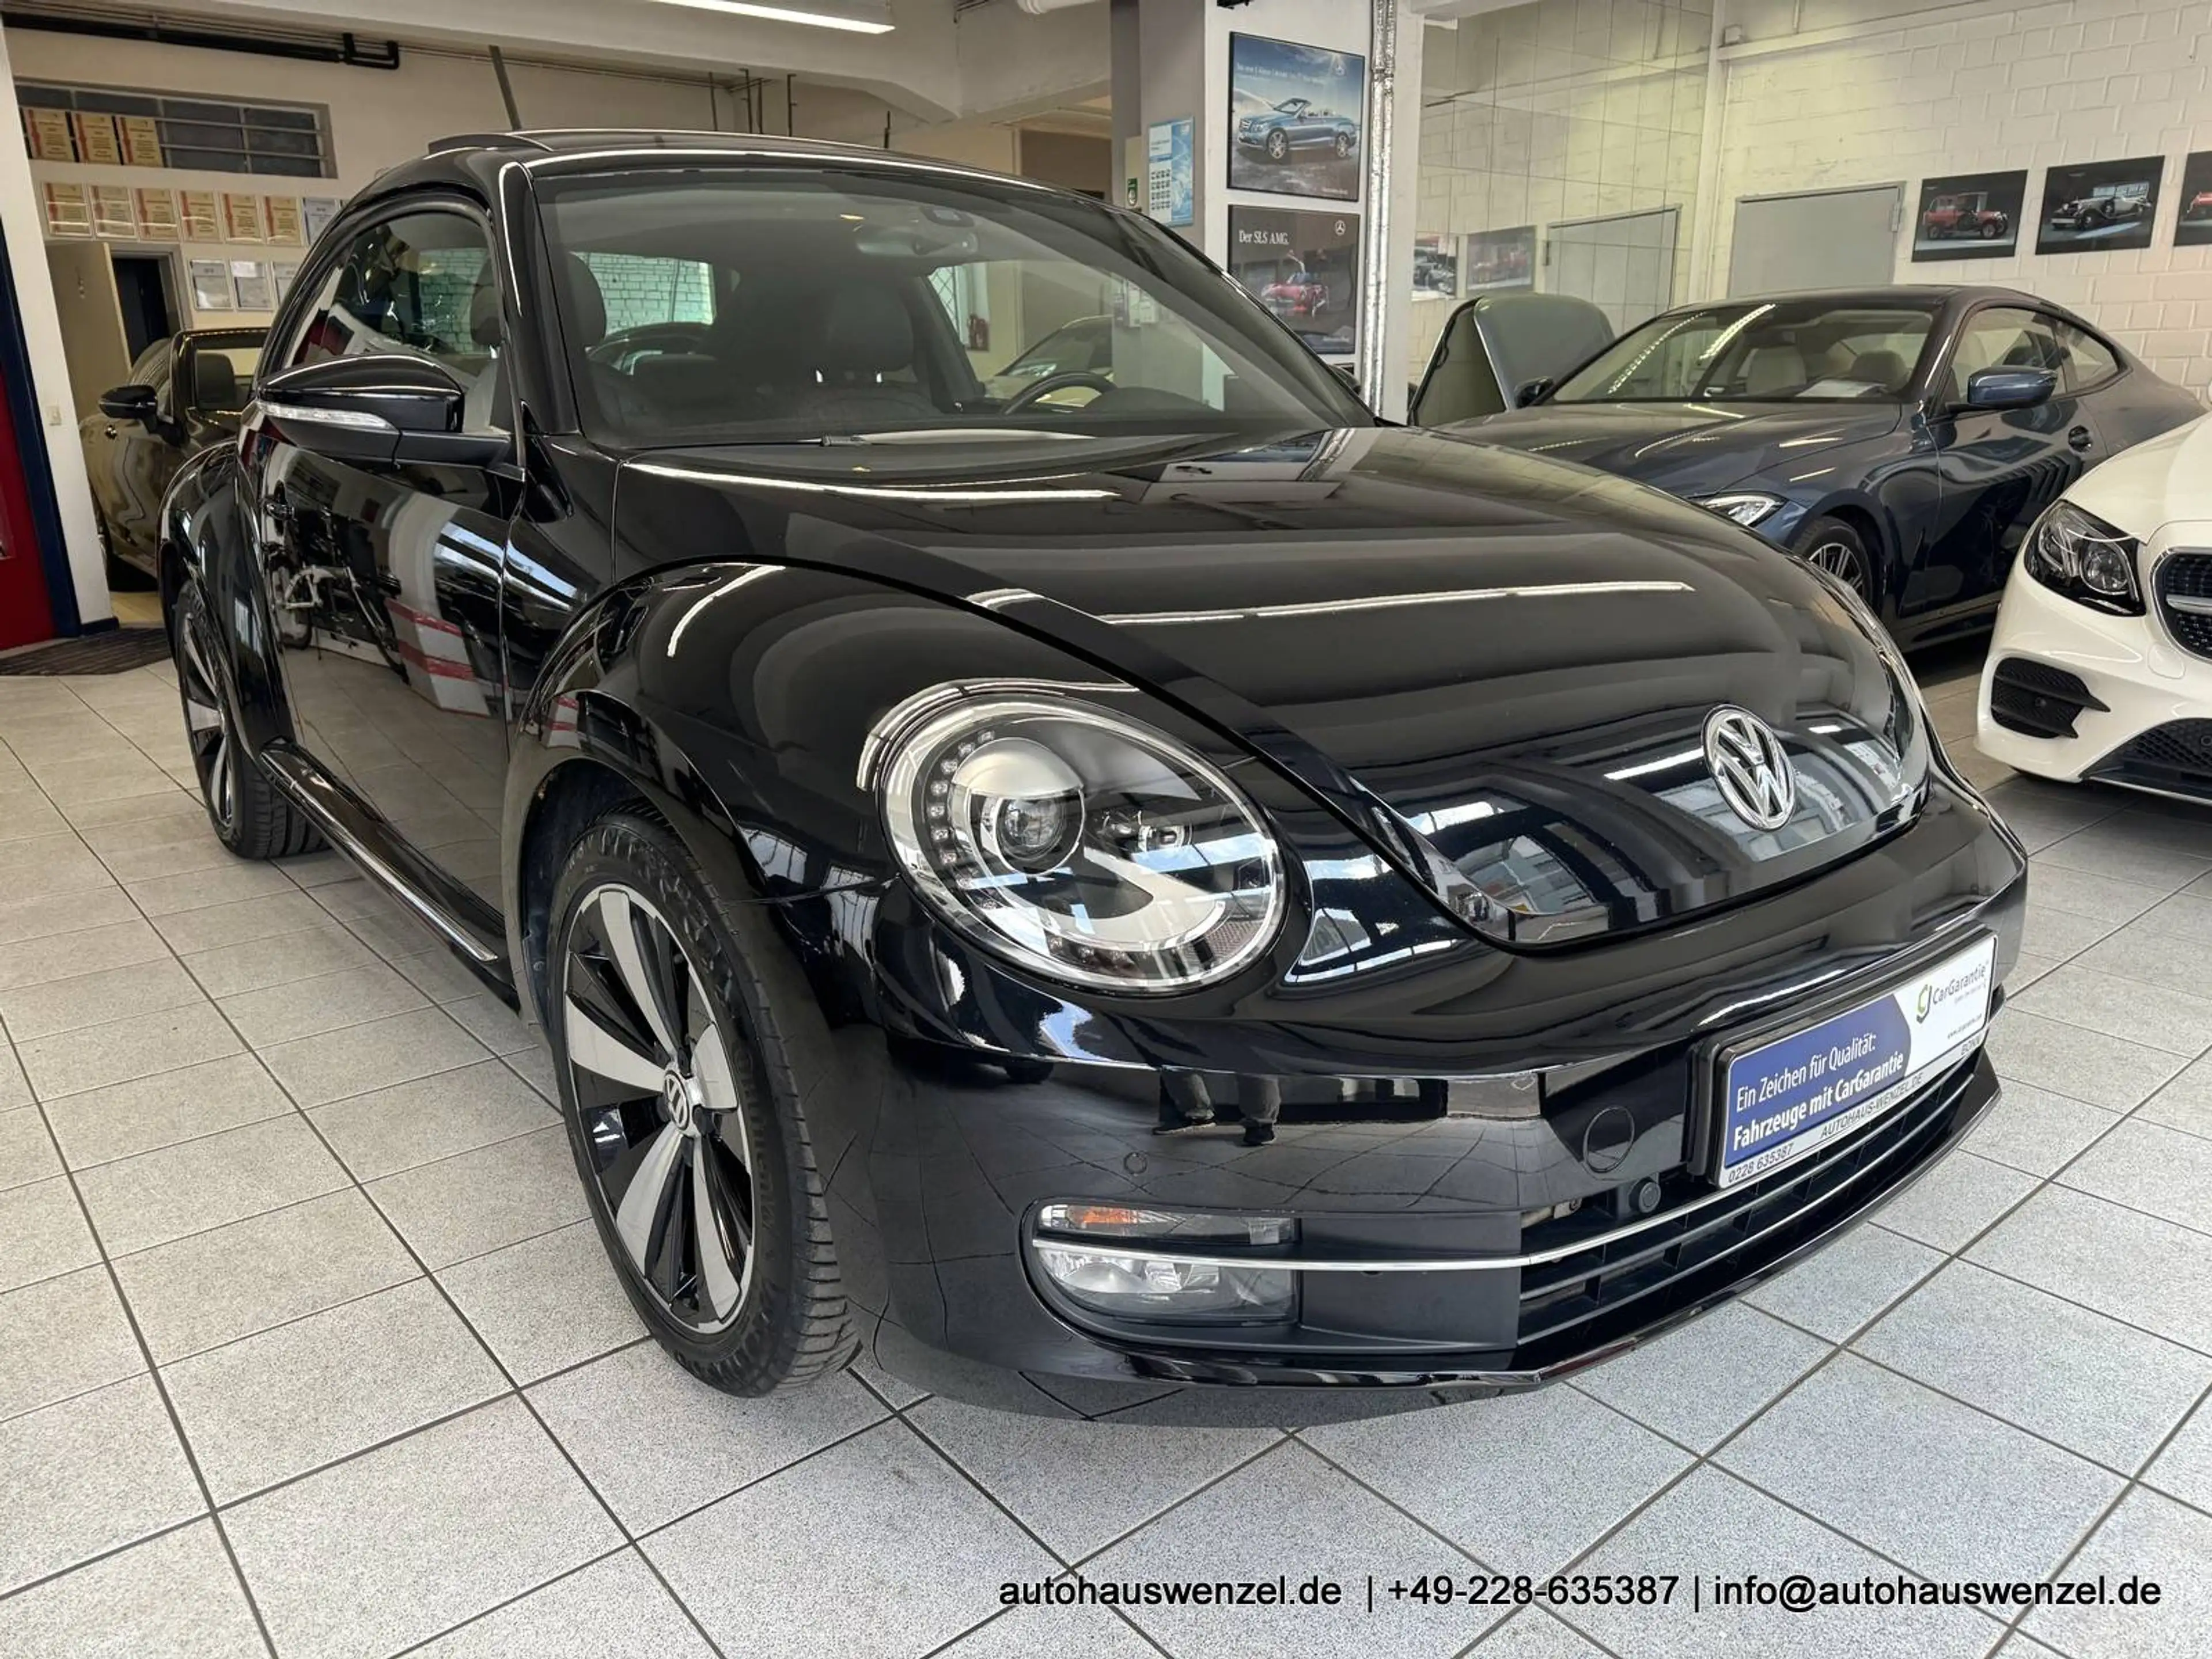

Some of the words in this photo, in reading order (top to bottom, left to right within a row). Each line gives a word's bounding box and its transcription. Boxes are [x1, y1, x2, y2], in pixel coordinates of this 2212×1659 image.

[1238, 230, 1252, 243] Der
[1253, 230, 1268, 244] SLS
[1933, 963, 1986, 1005] CarGarantie
[1736, 1085, 1757, 1112] Ein
[1759, 1064, 1806, 1103] Zeichen
[1809, 1054, 1827, 1080] für
[1828, 1032, 1877, 1071] Qualität:
[1733, 1100, 1807, 1151] Fahrzeuge
[1809, 1086, 1833, 1116] mit
[1835, 1051, 1904, 1102] CarGarantie
[1728, 1161, 1755, 1183] 0228
[1757, 1143, 1794, 1169] 635387
